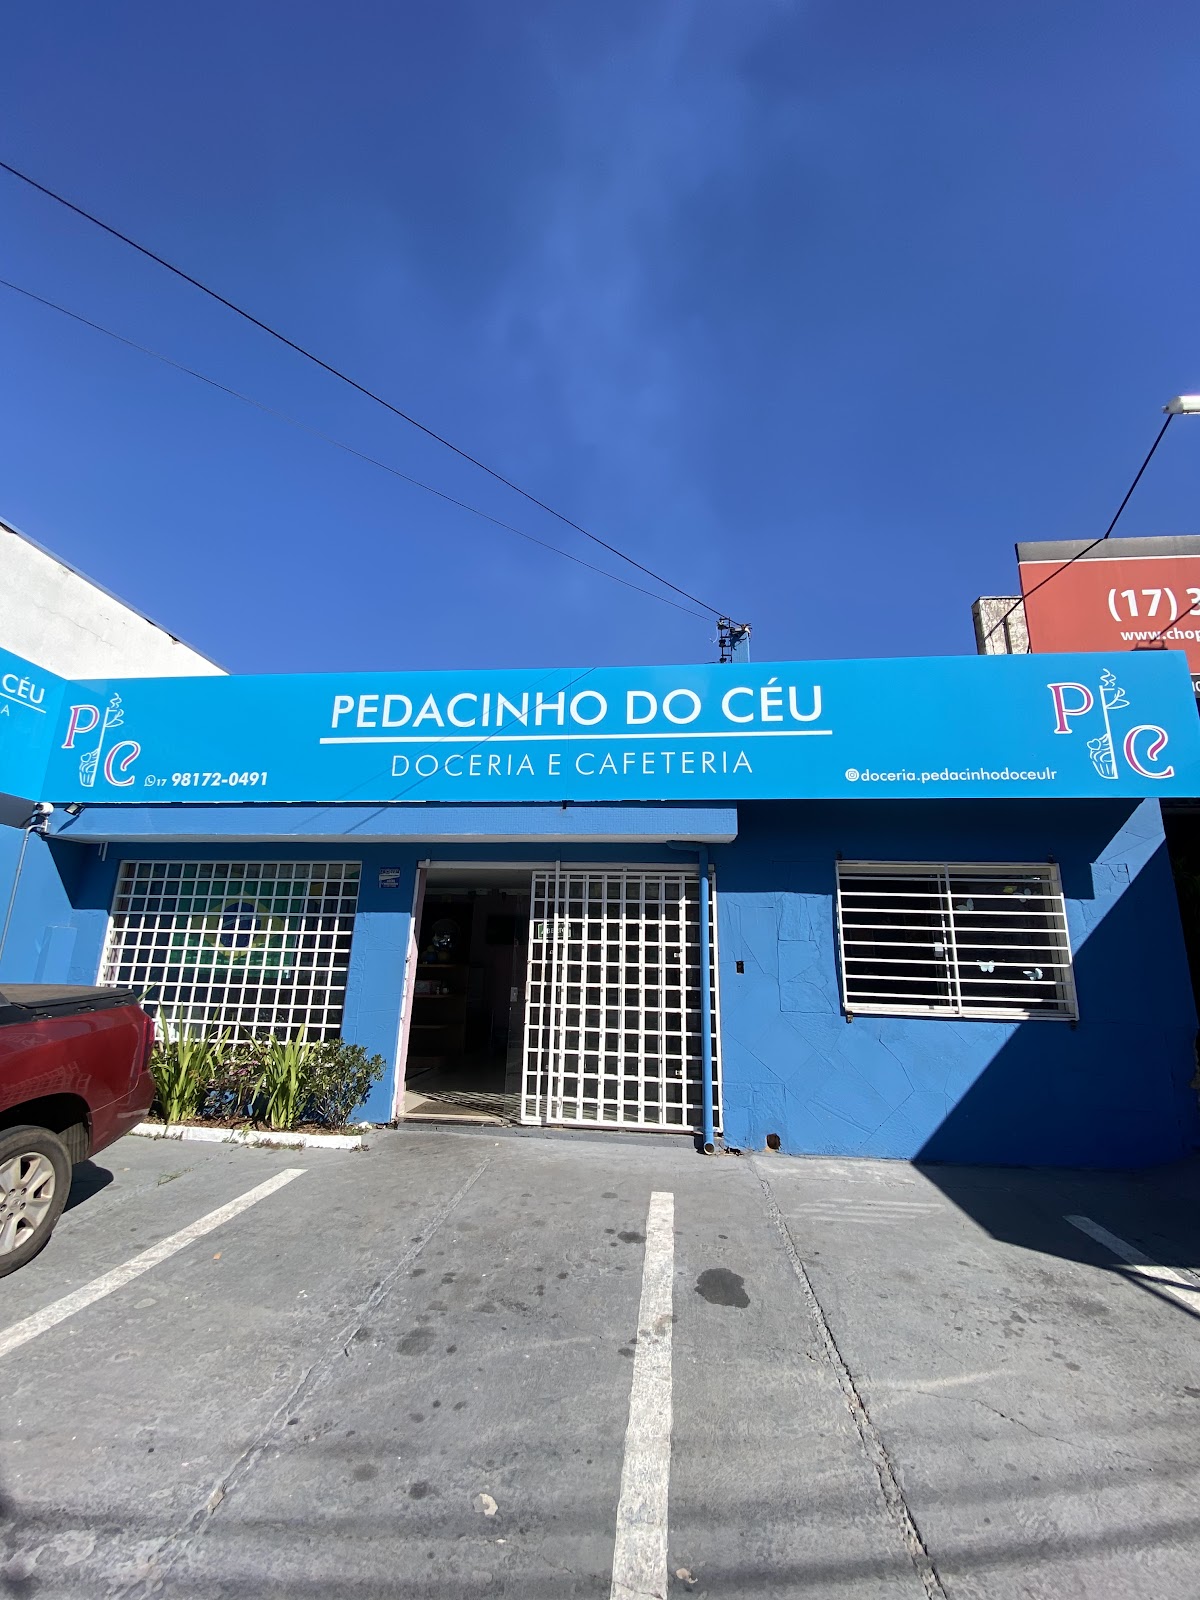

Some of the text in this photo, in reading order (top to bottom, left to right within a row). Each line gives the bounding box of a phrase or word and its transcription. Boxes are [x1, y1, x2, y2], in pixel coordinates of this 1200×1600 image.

[1108, 587, 1178, 622] (17)
[2, 673, 45, 704] CÉU
[331, 677, 822, 729] PEDACINHO DO CÉU
[1047, 682, 1094, 734] P
[61, 704, 100, 749] P
[156, 771, 268, 787] 17 98172-0491
[391, 750, 753, 777] DOCERIA E CAFETERIA
[860, 767, 1058, 784] doceria.pedacinhodoceulr
